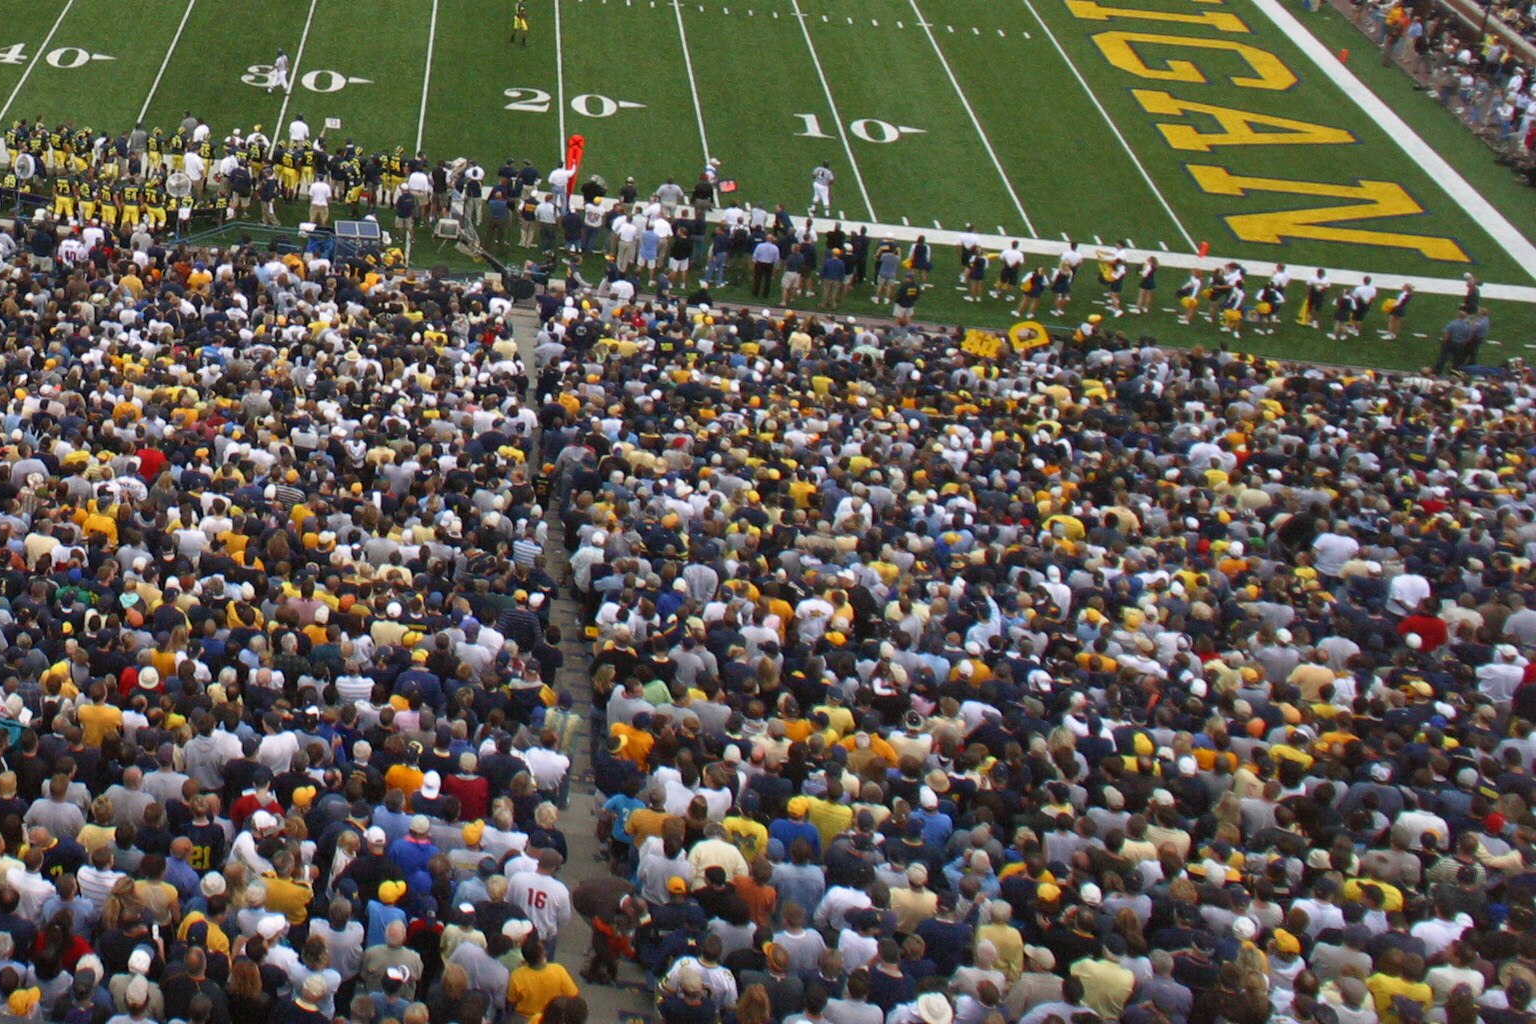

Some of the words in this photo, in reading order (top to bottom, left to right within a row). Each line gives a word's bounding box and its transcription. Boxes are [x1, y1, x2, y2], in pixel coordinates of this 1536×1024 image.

[503, 87, 618, 117] 20
[794, 113, 900, 144] 10
[189, 845, 211, 870] 21
[527, 887, 548, 910] 16
